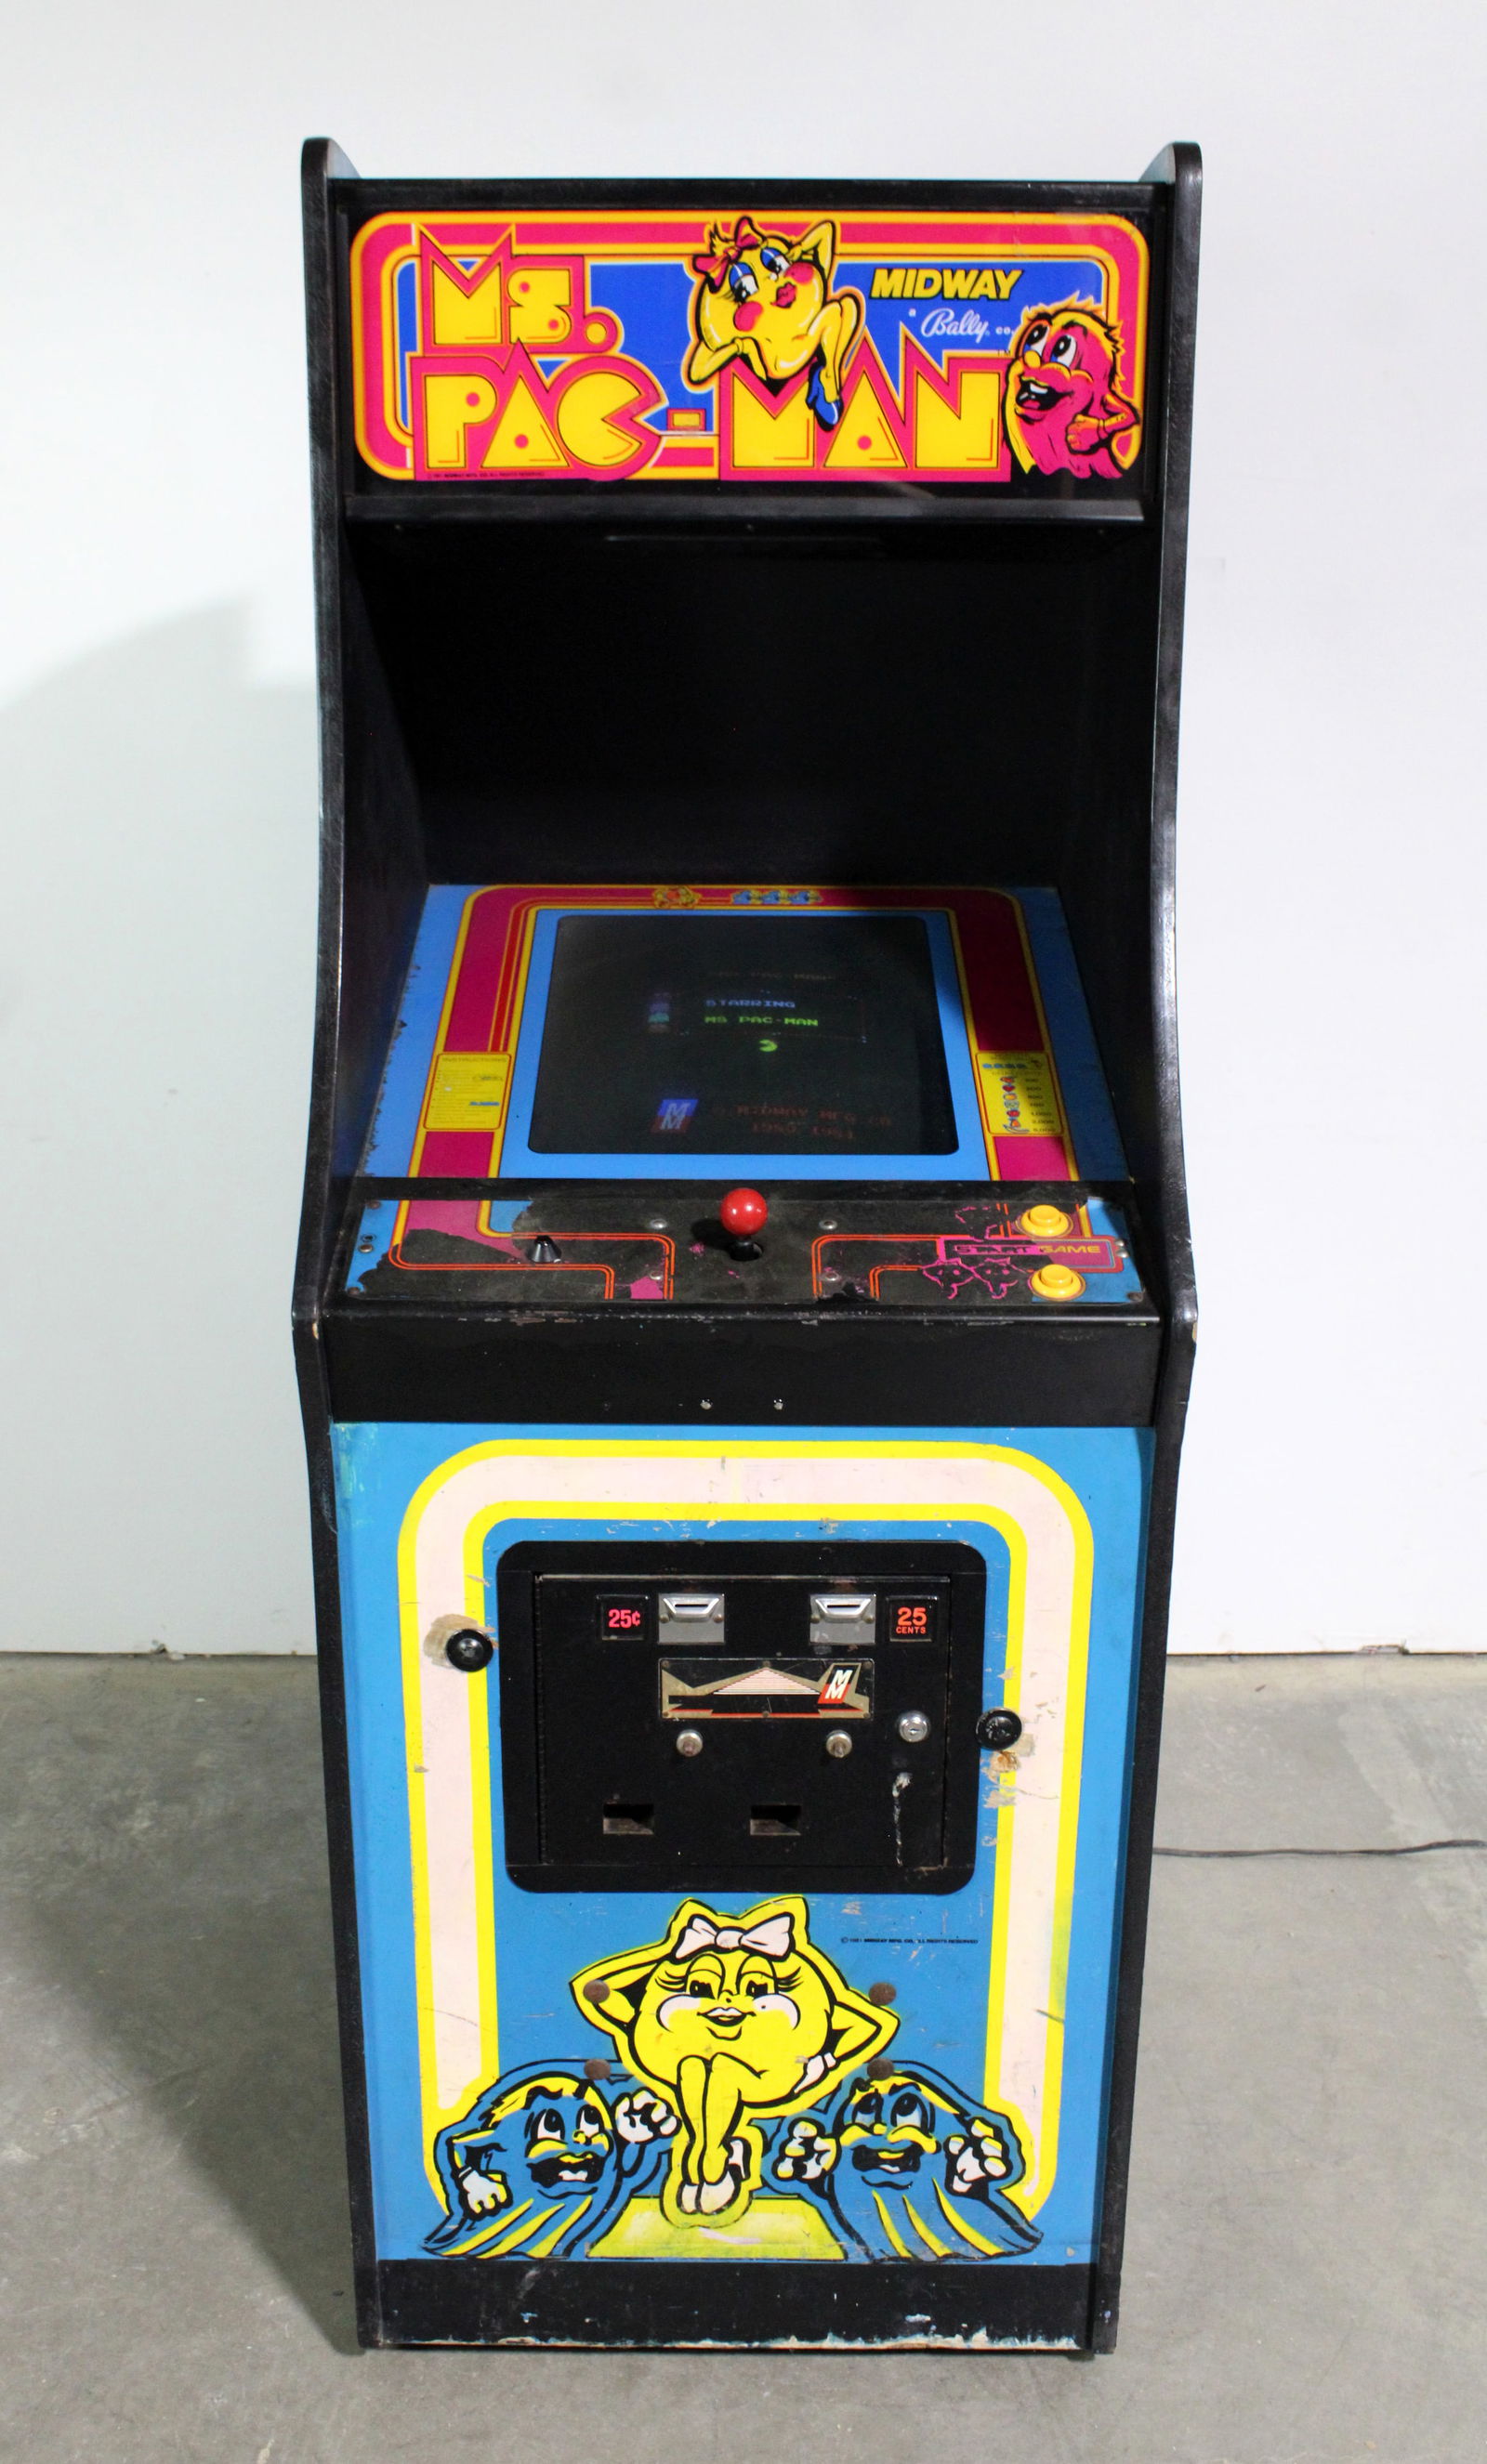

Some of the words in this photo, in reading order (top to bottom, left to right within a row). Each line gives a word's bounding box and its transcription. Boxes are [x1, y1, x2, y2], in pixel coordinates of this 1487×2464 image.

[868, 267, 1023, 301] MIDWAY
[423, 242, 614, 350] MS.
[921, 308, 989, 344] Bally
[416, 355, 1008, 474] PAC-MAN
[704, 998, 796, 1011] STARRING
[1039, 1244, 1101, 1254] GAME
[609, 1608, 640, 1628] 25¢
[897, 1606, 928, 1627] 25
[895, 1626, 927, 1634] CENTS
